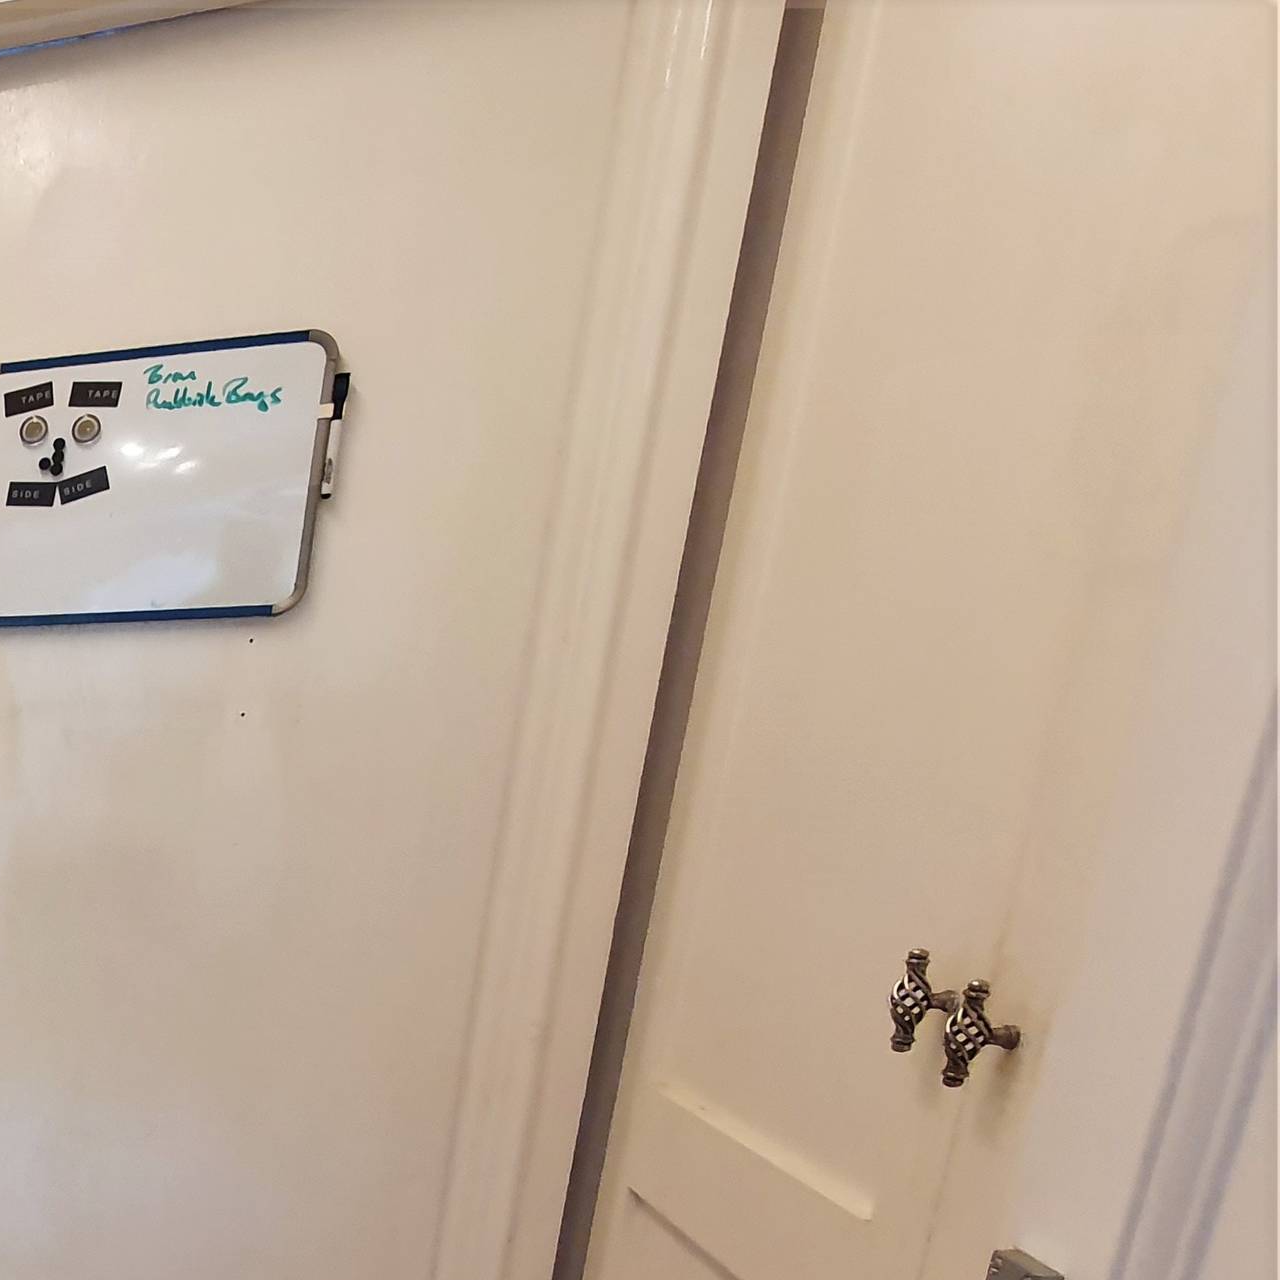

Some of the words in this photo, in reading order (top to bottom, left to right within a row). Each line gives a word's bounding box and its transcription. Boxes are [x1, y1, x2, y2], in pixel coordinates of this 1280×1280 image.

[21, 389, 51, 405] TAPE
[87, 389, 119, 400] TAPE
[63, 479, 93, 496] SIDE
[11, 489, 41, 500] SIDE
